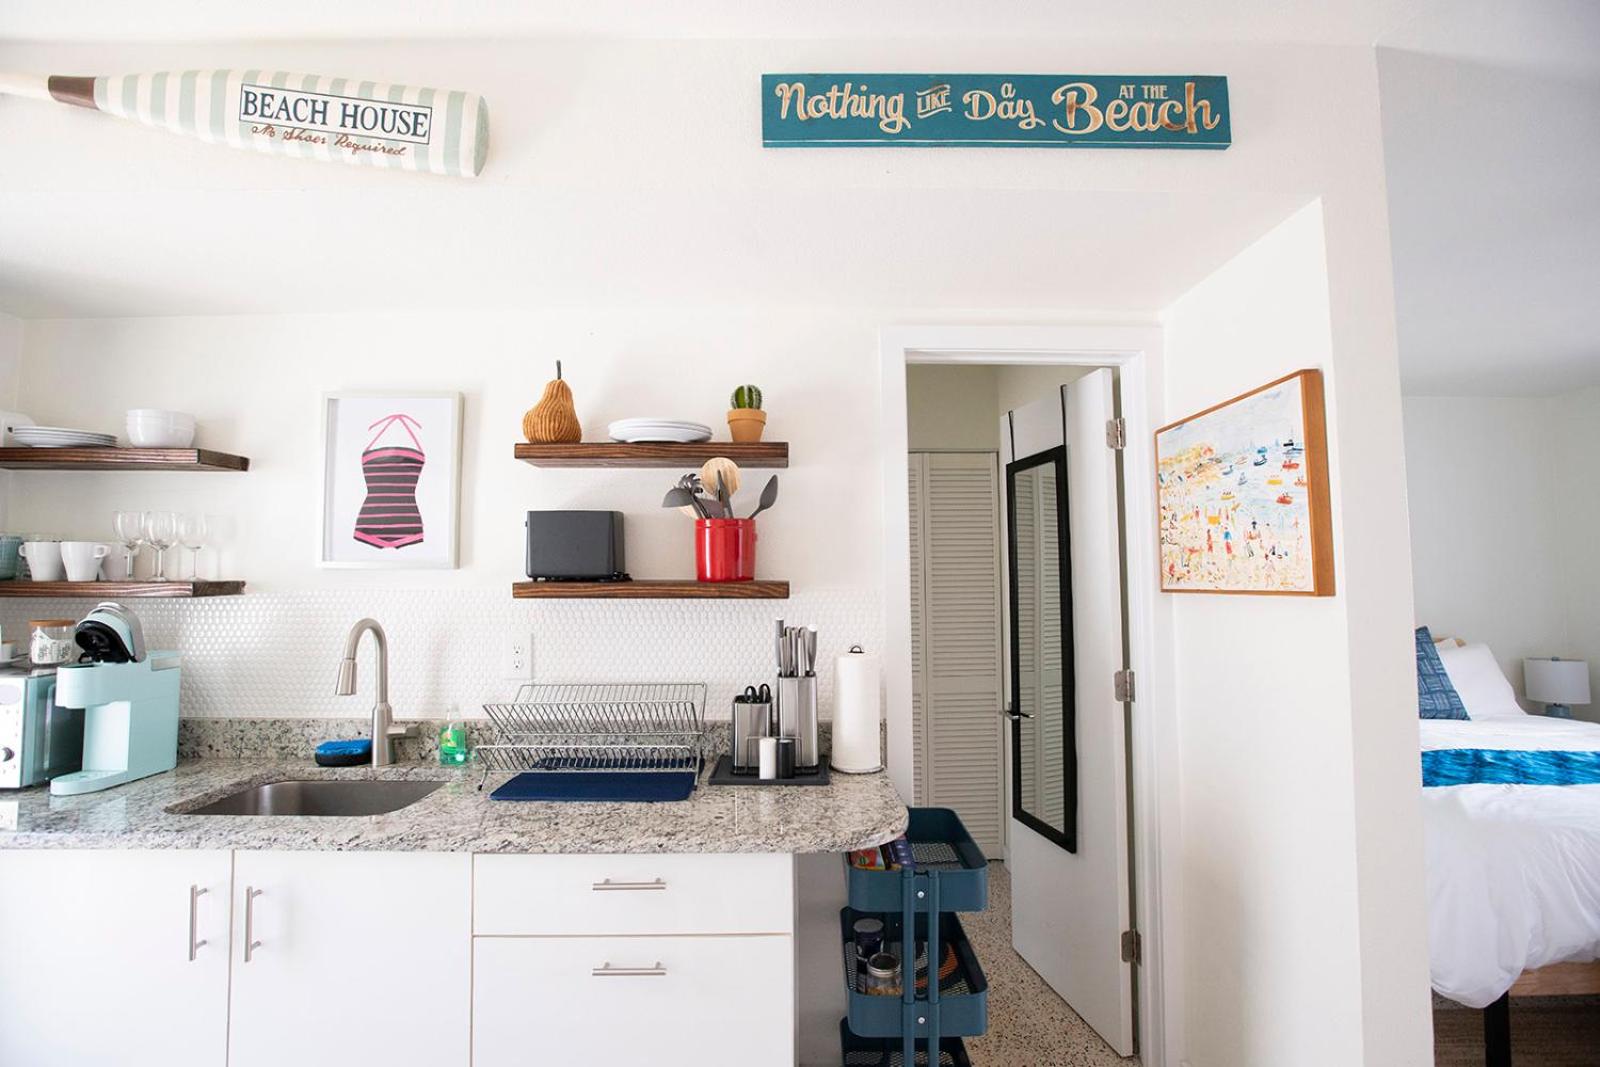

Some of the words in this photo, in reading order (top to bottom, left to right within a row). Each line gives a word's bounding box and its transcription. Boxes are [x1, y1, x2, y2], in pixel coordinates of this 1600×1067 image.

[916, 88, 951, 115] LIKE
[1001, 82, 1016, 99] a
[1119, 84, 1136, 99] AT
[1141, 84, 1169, 100] THE
[242, 90, 330, 126] BEACH
[339, 102, 429, 138] HOUSE
[774, 82, 912, 134] Nothing
[962, 90, 1046, 130] Day
[1051, 82, 1221, 135] Beach
[252, 124, 275, 137] No
[283, 127, 328, 145] Shoes
[334, 134, 407, 156] Required
